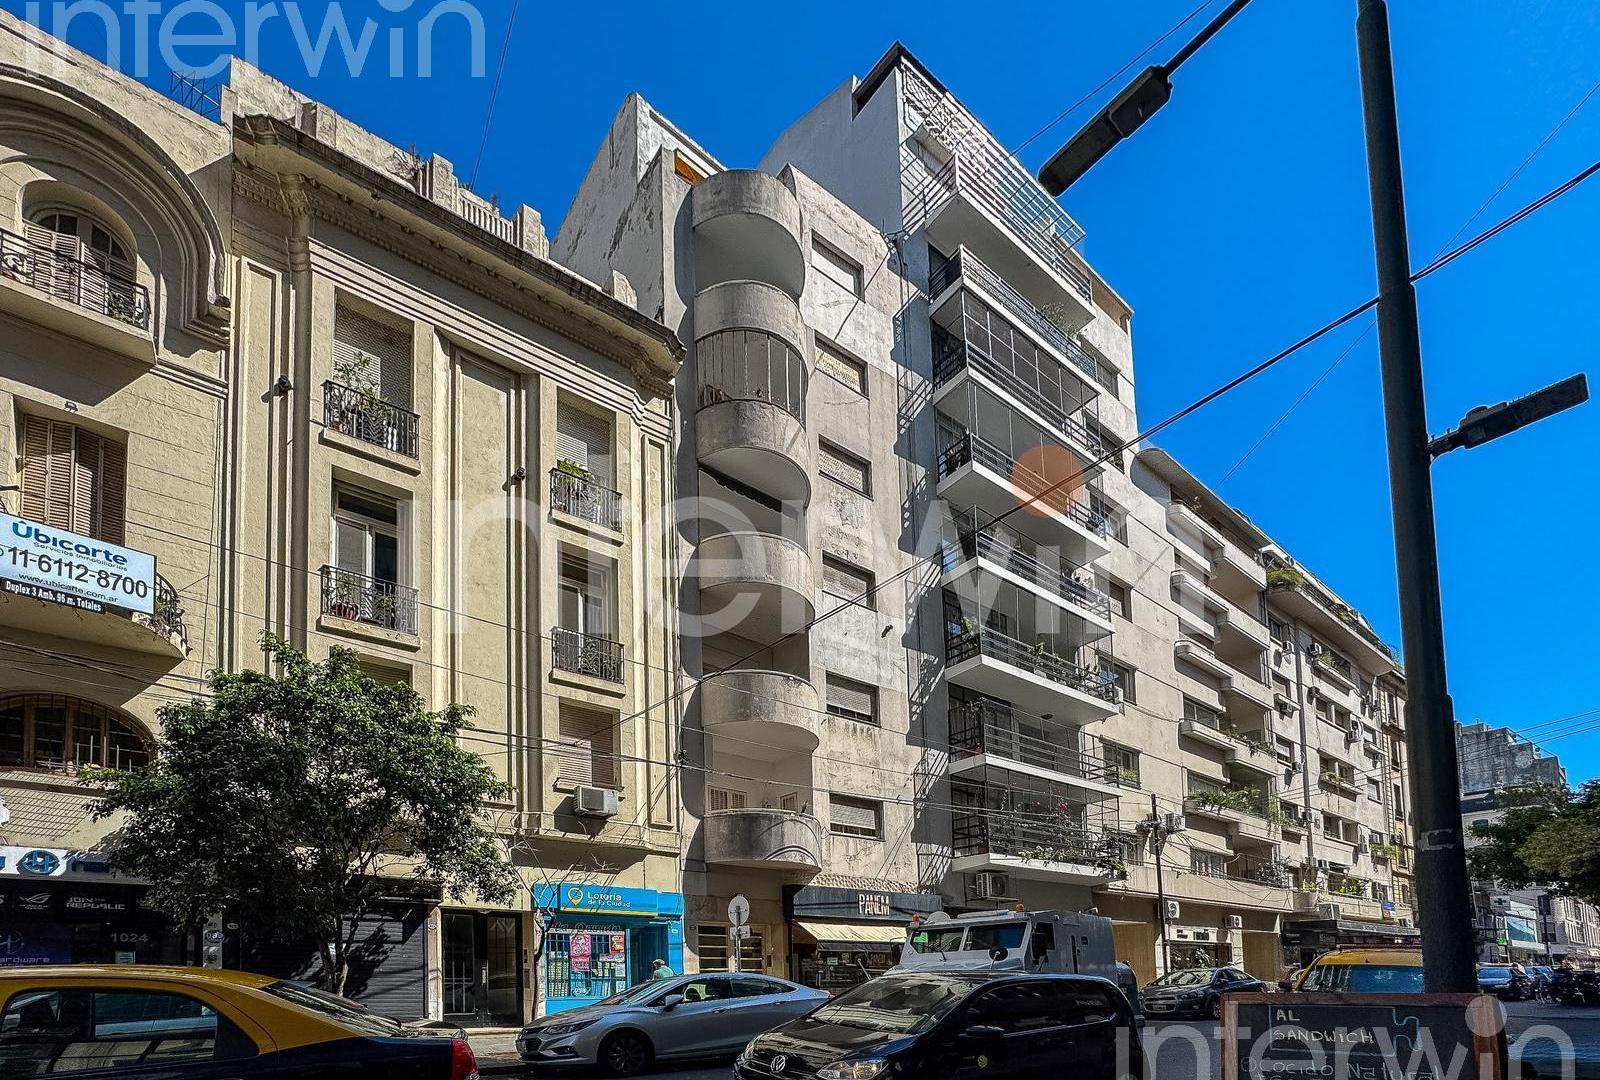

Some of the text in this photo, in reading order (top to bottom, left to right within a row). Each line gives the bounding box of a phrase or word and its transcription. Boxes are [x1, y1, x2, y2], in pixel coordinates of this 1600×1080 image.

[33, 541, 128, 572] Servicios Inmobiliarios
[8, 546, 148, 599] 11-6112-8700
[6, 580, 30, 595] Duplex
[31, 587, 37, 596] 3
[38, 588, 56, 601] Amb.
[77, 597, 101, 612] Totales
[18, 573, 118, 603] www.ubicarte.com.ar
[66, 902, 126, 910] REPUBLIC
[859, 894, 890, 916] PANEM
[110, 932, 150, 943] 1024
[1276, 1009, 1301, 1021] AL
[1273, 1028, 1375, 1044] SANDWICH
